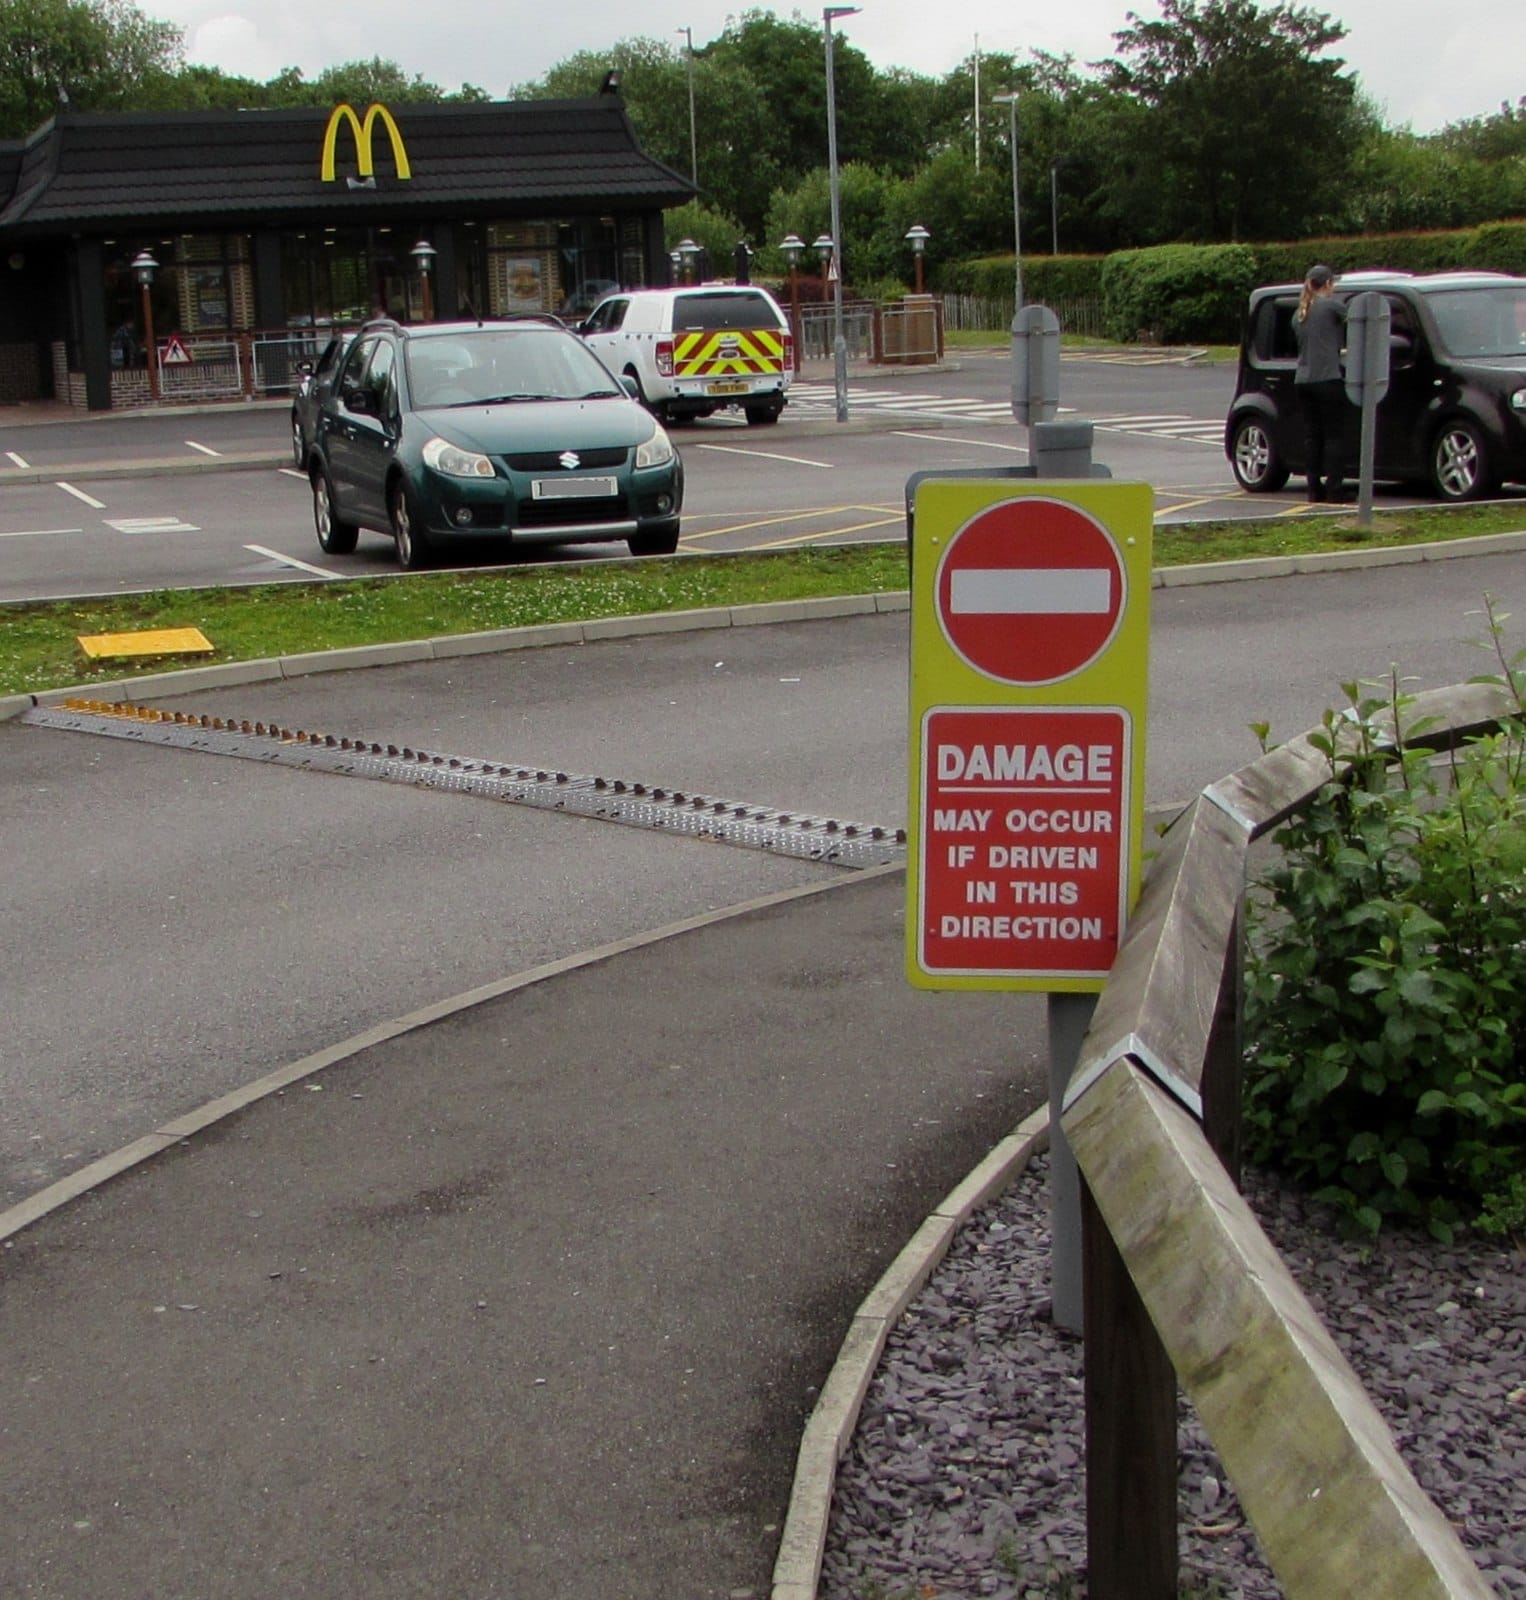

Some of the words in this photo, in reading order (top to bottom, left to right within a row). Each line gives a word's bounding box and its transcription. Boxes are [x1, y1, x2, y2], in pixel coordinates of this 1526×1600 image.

[937, 744, 1112, 781] DAMAGE
[933, 809, 993, 832] MAY
[1005, 809, 1112, 833] OCCUR
[948, 846, 975, 868] IF
[989, 846, 1097, 869] DRIVEN
[966, 881, 996, 904] IN
[1010, 881, 1078, 905] THIS
[941, 916, 1101, 940] DIRECTION
